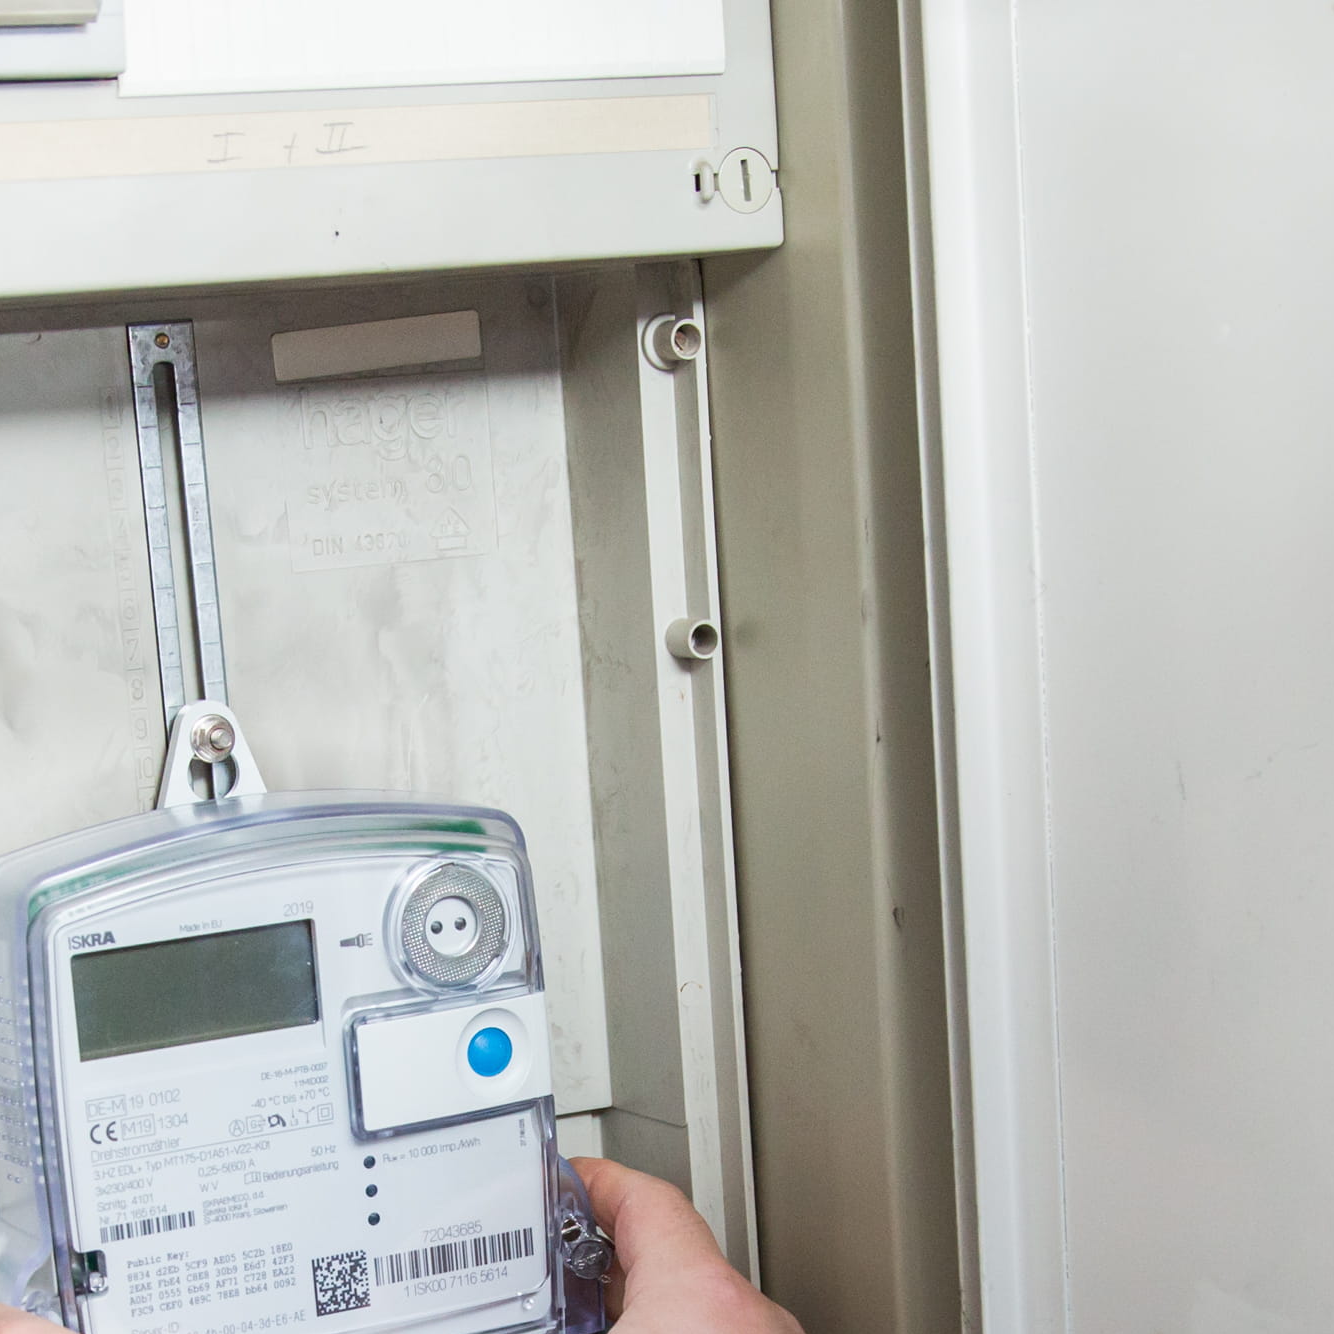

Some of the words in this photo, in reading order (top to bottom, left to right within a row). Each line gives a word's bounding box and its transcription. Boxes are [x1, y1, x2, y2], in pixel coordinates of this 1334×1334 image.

[299, 386, 460, 462] hager
[307, 479, 404, 512] system
[426, 454, 472, 494] 80
[313, 536, 343, 556] DIN
[283, 901, 314, 917] 2019
[179, 921, 200, 933] Made
[211, 919, 222, 930] EU
[68, 931, 116, 950] ISKRA
[87, 1100, 125, 1118] DE-M
[130, 1096, 144, 1110] 19
[149, 1088, 181, 1107] 0102
[268, 1094, 281, 1106] °C
[282, 1092, 297, 1104] bis
[299, 1088, 316, 1102] +70
[317, 1086, 330, 1098] °C
[123, 1119, 153, 1136] M19
[157, 1112, 189, 1131] 1304
[91, 1138, 181, 1164] Drehstromzähler
[311, 1146, 324, 1158] 50
[324, 1144, 337, 1155] Hz
[408, 1148, 420, 1159] 10
[421, 1144, 439, 1156] 000
[145, 1159, 163, 1174] Typ
[248, 1159, 256, 1169] A
[263, 1160, 340, 1183] Bedienungsanleitung
[146, 1177, 154, 1188] V
[422, 1220, 483, 1243] 72043685
[127, 1255, 162, 1269] Public
[167, 1250, 190, 1263] Key:
[404, 1285, 411, 1297] 1
[413, 1278, 447, 1296] ISK00
[450, 1272, 478, 1289] 7116
[480, 1266, 509, 1284] 5614
